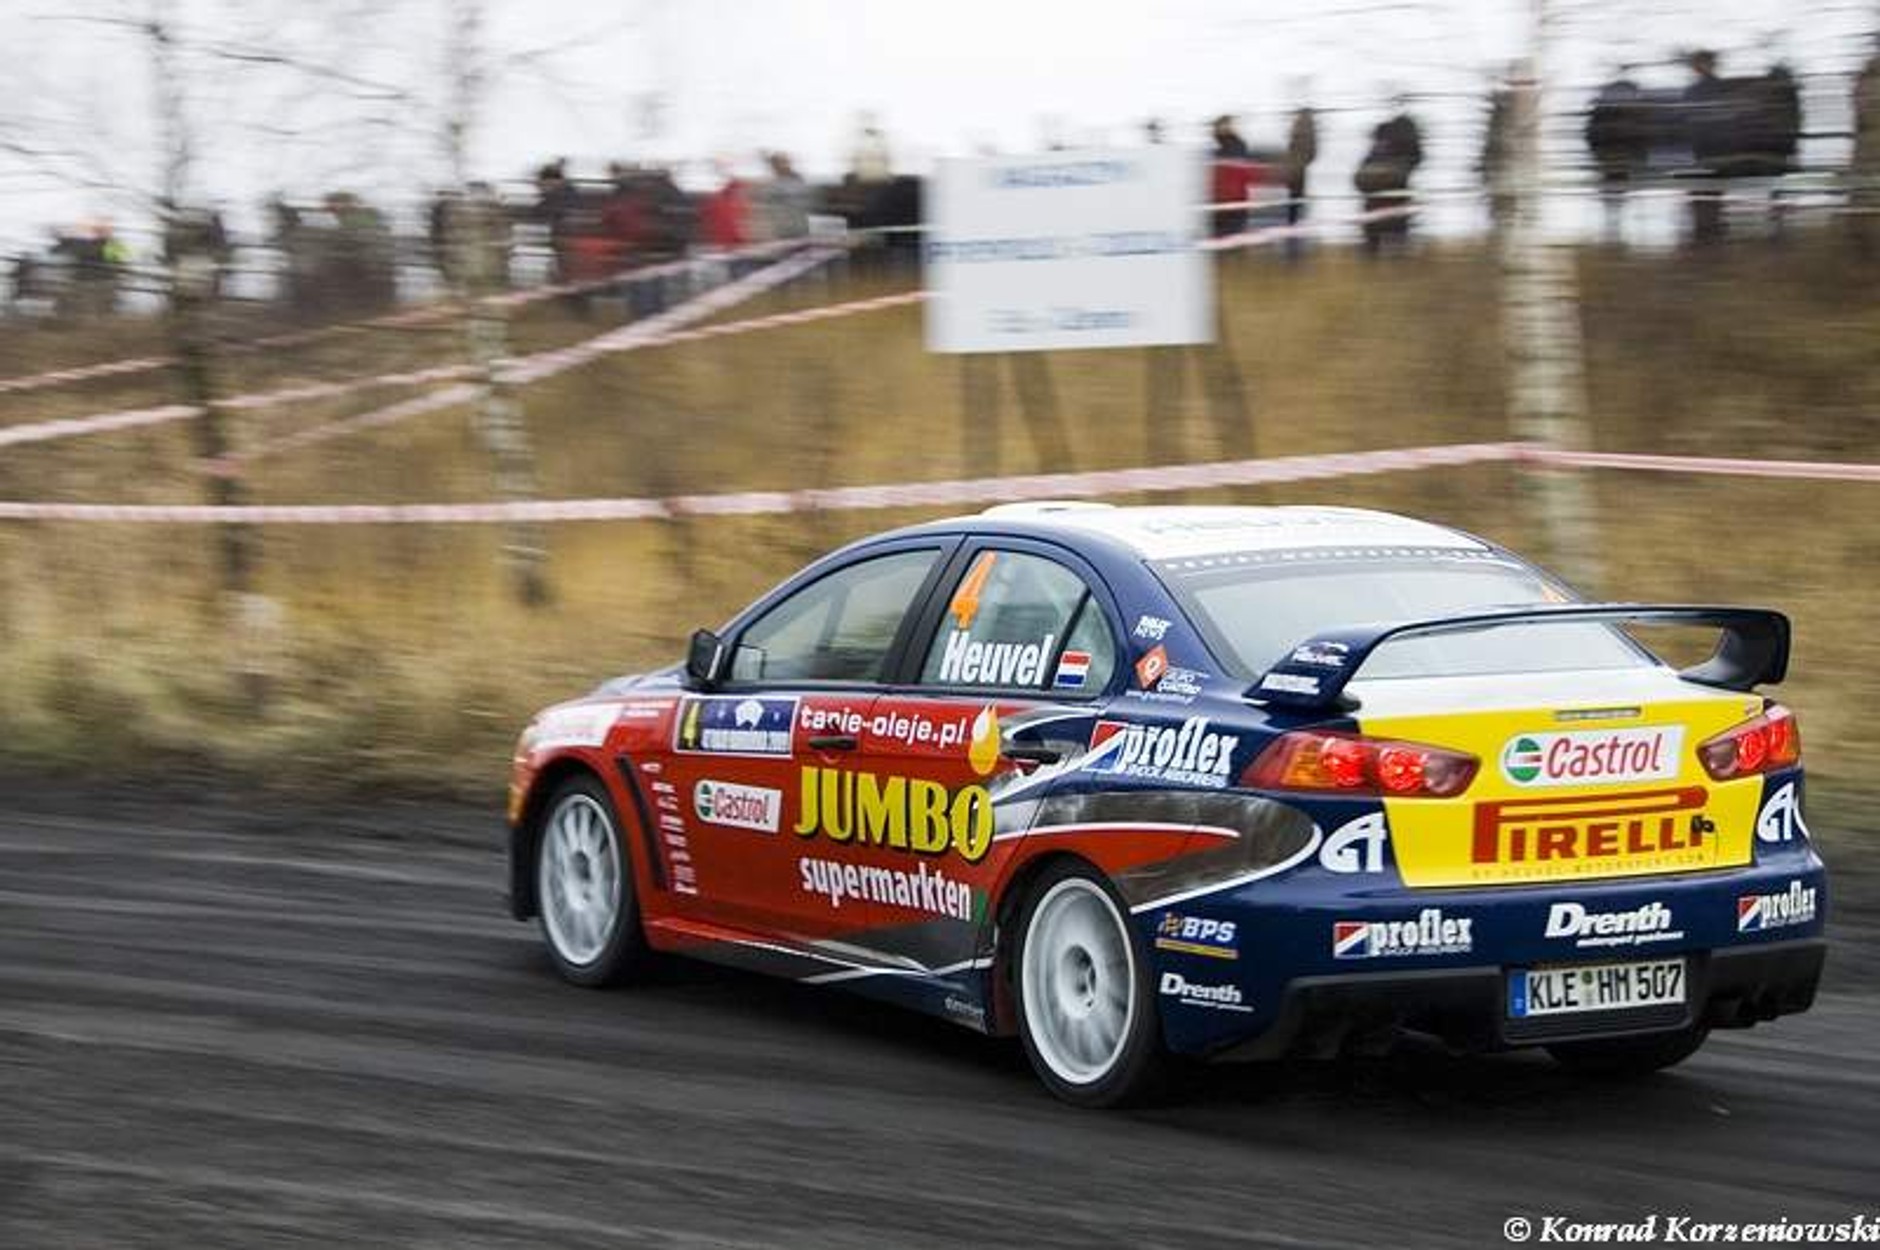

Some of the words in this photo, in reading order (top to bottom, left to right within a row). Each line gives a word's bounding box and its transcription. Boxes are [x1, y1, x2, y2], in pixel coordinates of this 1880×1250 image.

[950, 550, 998, 630] 4
[940, 630, 1054, 686] Heuvel
[801, 704, 967, 748] tanie-oleje.pl
[1115, 716, 1239, 774] proflex
[1546, 732, 1663, 779] Castrol
[713, 787, 769, 824] Castrol
[794, 765, 994, 861] JUMBO
[800, 857, 971, 922] supermarkten
[1760, 881, 1817, 929] proflex
[1182, 916, 1237, 943] BPS
[1370, 909, 1473, 956] proflex
[1544, 902, 1672, 938] Drenth
[1160, 972, 1242, 1004] Drenth
[1528, 971, 1579, 1010] KLE
[1599, 968, 1630, 1004] HM
[1637, 963, 1684, 1000] 507
